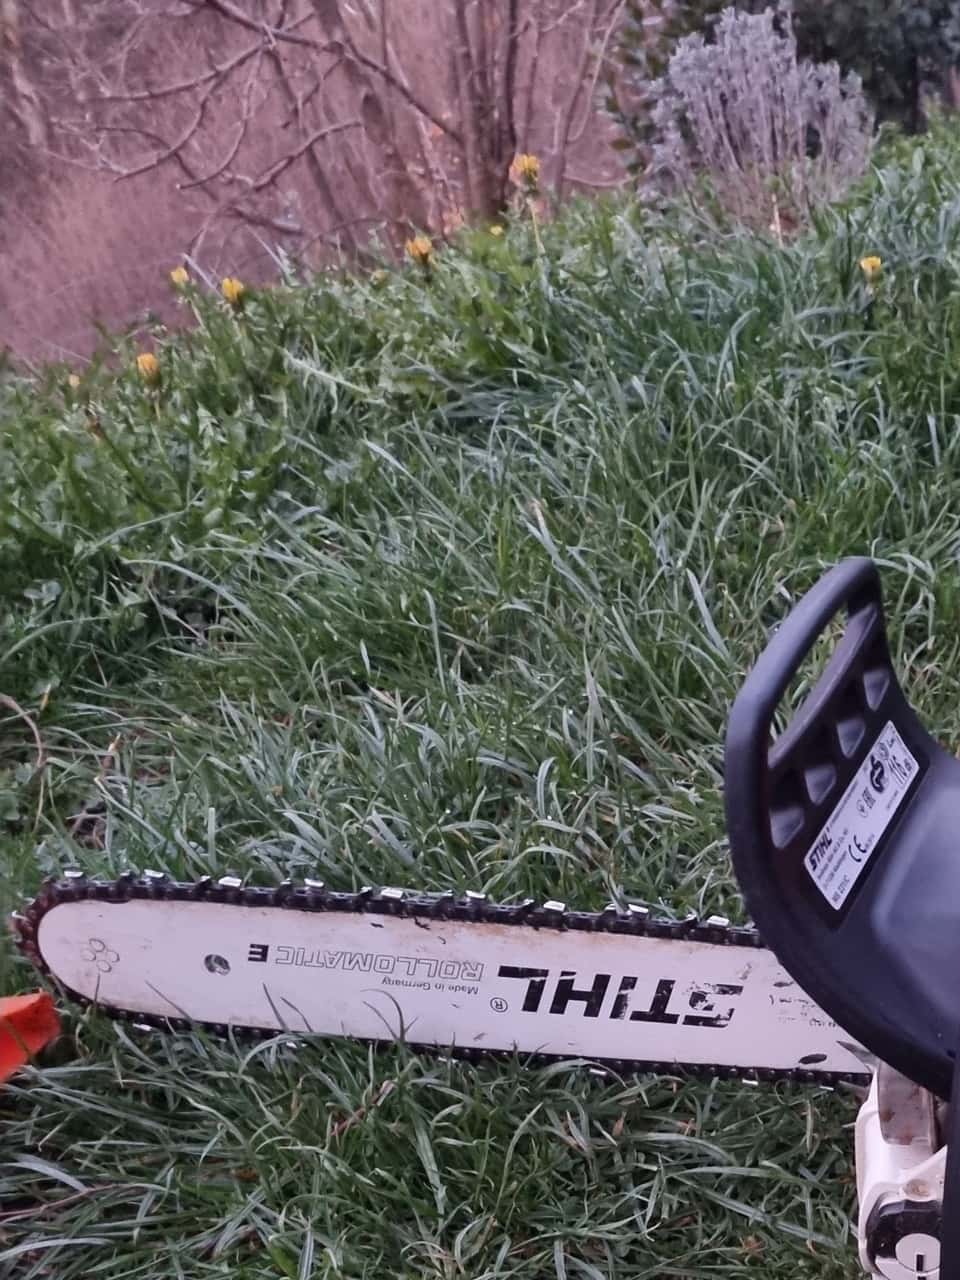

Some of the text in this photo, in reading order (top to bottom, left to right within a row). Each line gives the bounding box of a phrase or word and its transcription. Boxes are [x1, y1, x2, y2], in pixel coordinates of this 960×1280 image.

[808, 833, 833, 871] STIHL
[248, 944, 484, 982] ROLLOMATIC E
[381, 977, 478, 995] Made in Germany
